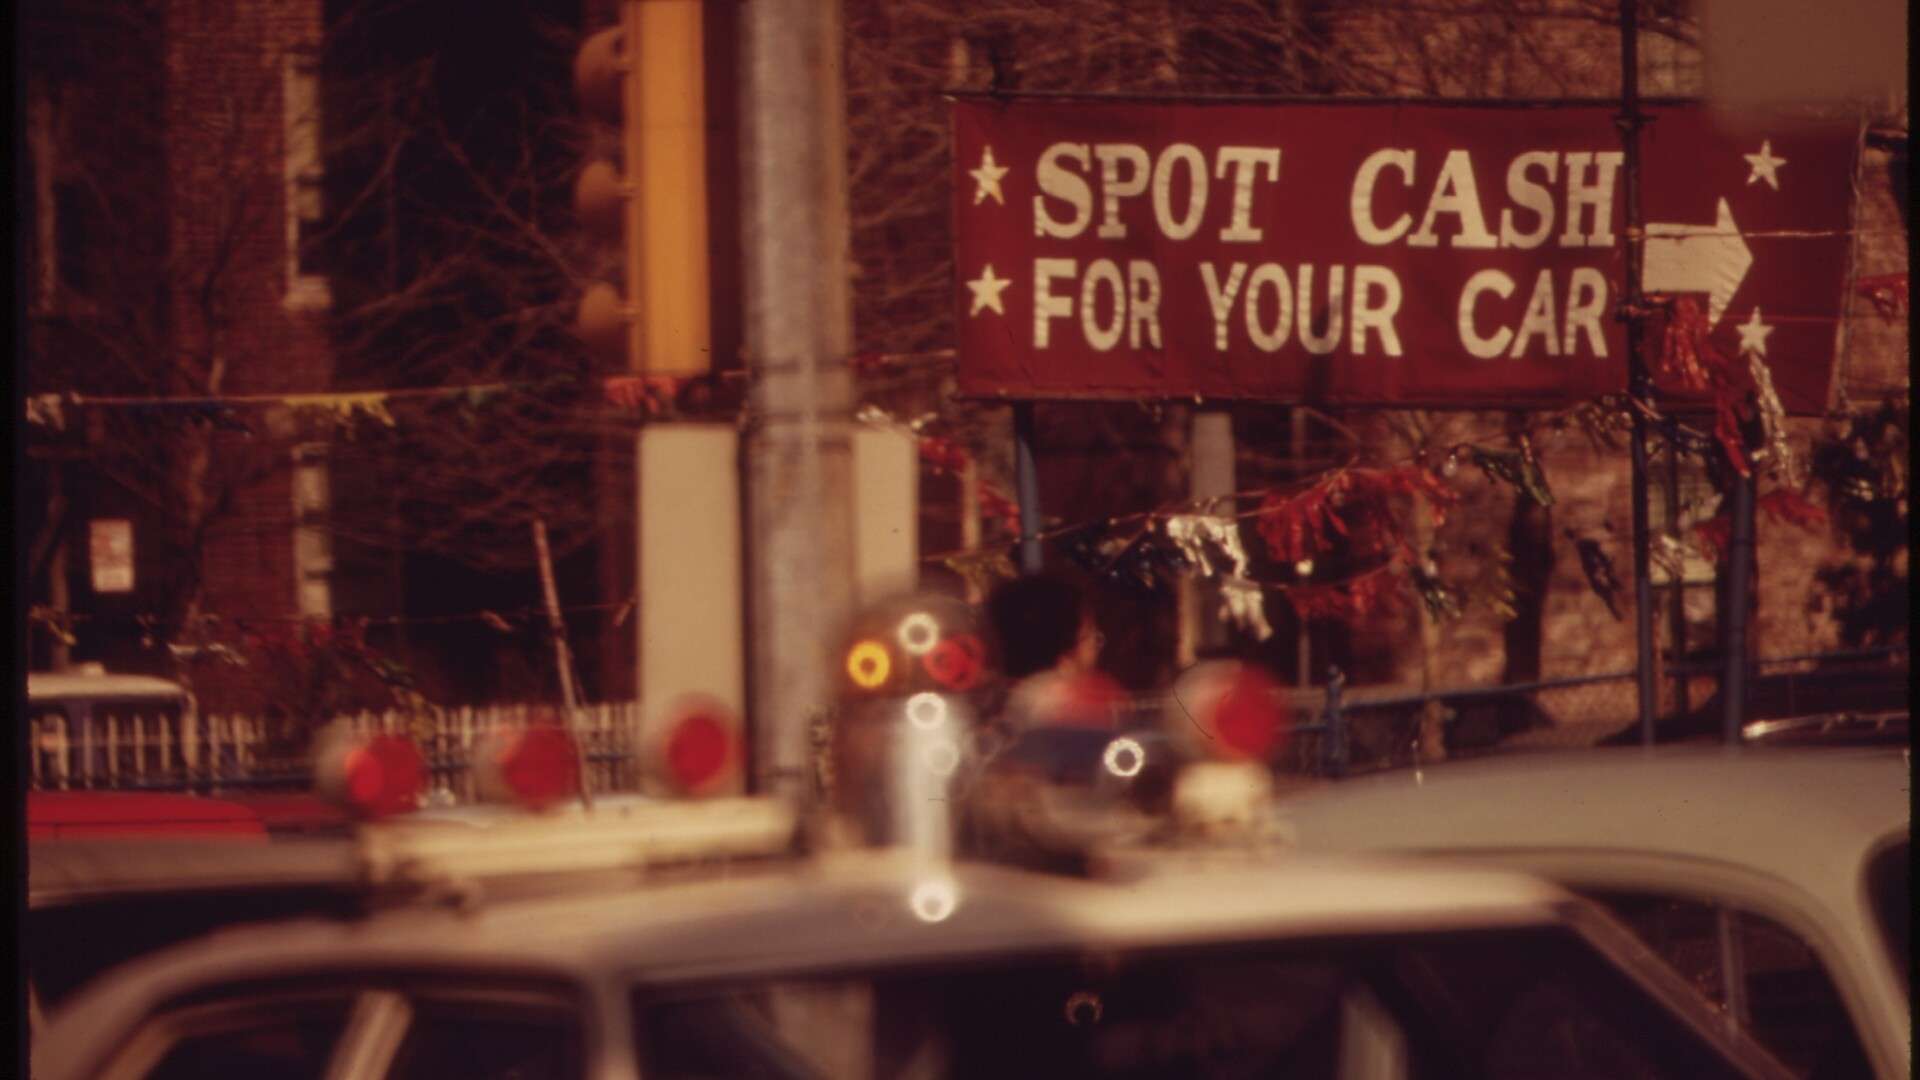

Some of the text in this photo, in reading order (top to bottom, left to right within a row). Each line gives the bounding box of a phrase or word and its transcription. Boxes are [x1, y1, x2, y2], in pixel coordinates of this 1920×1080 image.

[1033, 142, 1625, 249] SPOT CASH
[1033, 257, 1609, 359] FOR YOUR CAR
